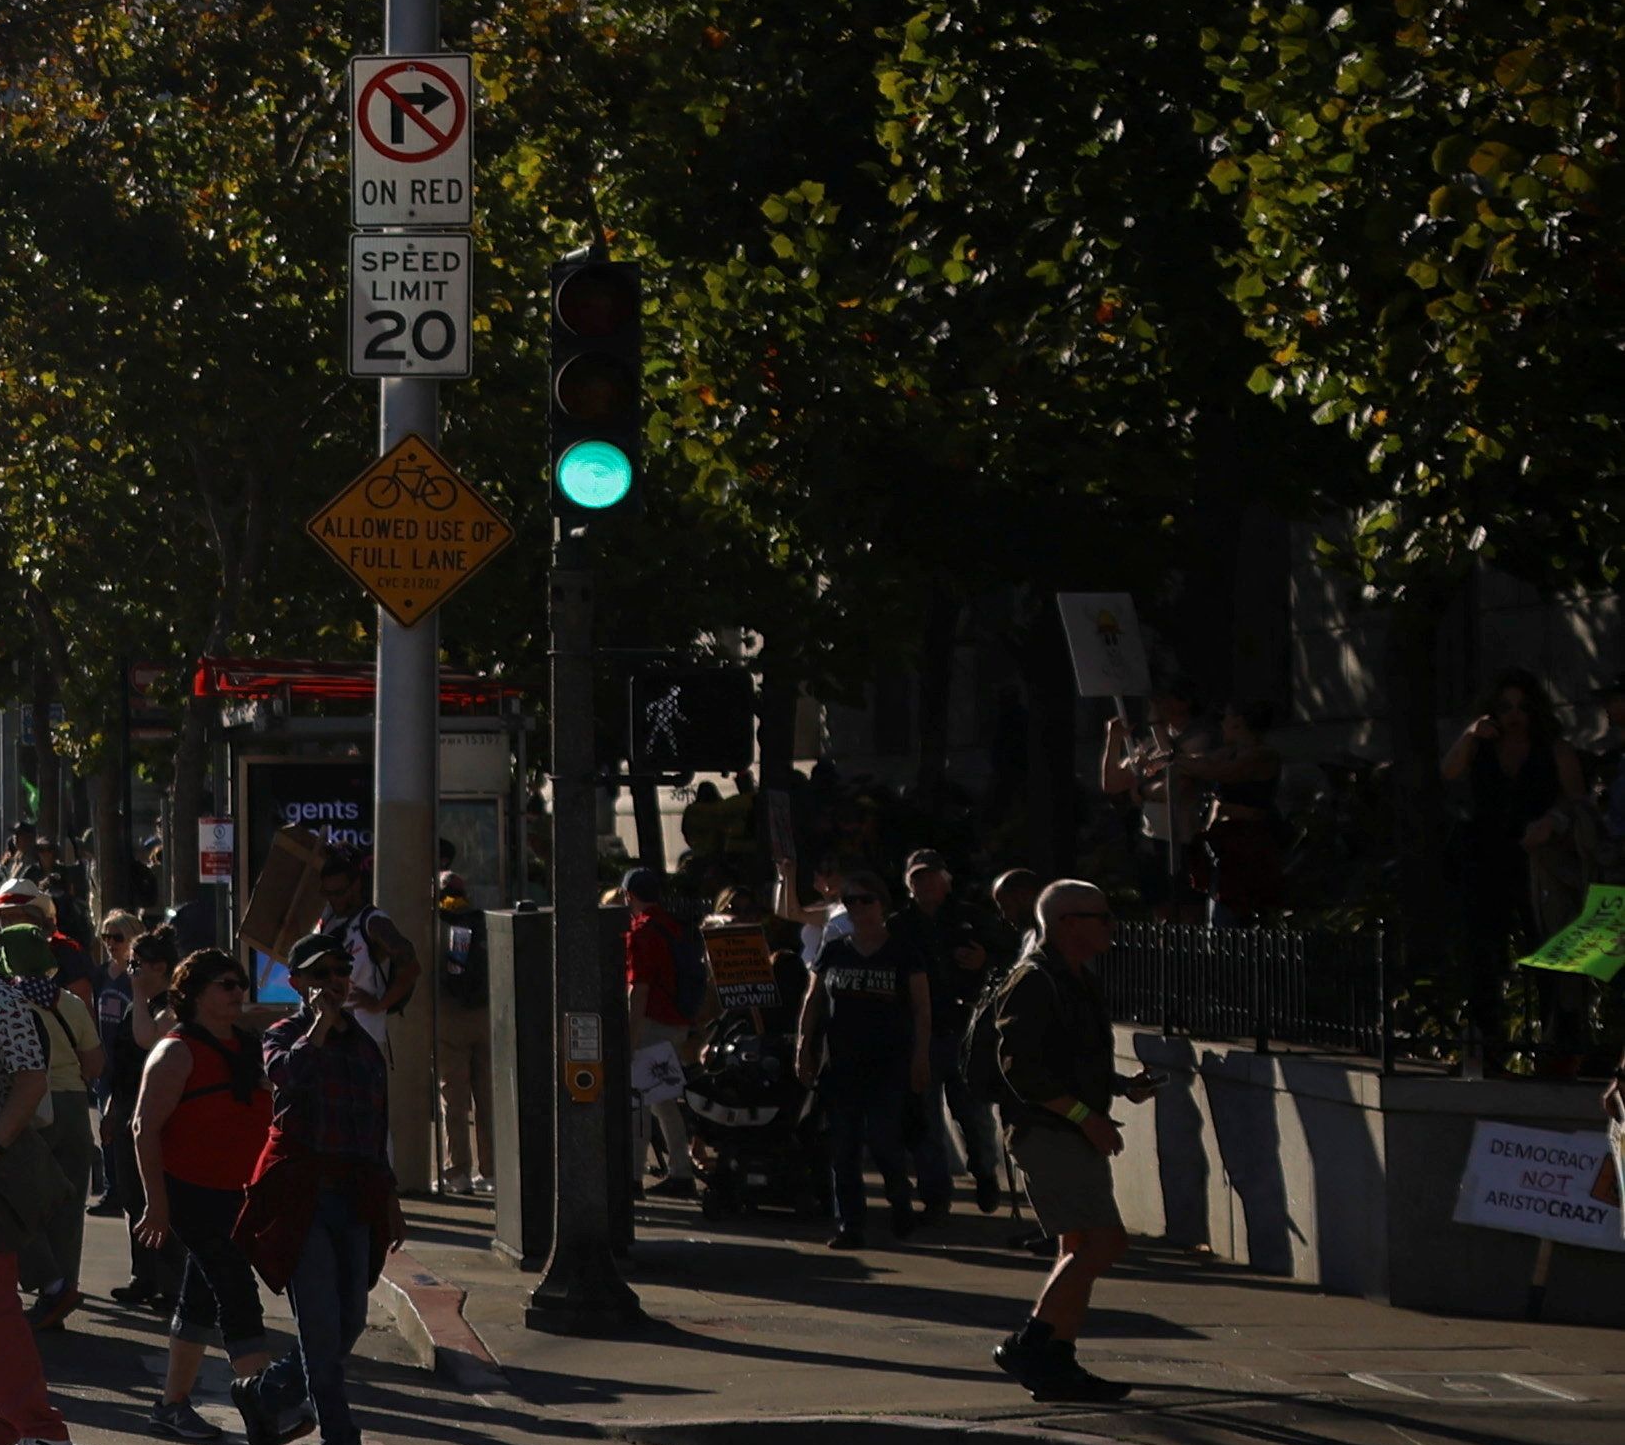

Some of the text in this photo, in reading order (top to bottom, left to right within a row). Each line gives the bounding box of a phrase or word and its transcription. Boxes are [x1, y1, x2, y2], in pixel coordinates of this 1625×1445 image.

[362, 179, 463, 205] ON RED
[361, 251, 460, 272] SPEED
[372, 280, 448, 301] LIMIT
[364, 310, 456, 361] 20
[322, 517, 497, 542] ALLOWED USE OF
[350, 546, 468, 571] FULL LANE
[378, 576, 440, 590] CVC 21202
[719, 983, 754, 996] MUST
[836, 977, 862, 991] WE
[1490, 1138, 1599, 1170] DEMOCRACY
[1520, 1171, 1574, 1193] NOT
[1485, 1190, 1608, 1225] ARISTOCRAZY
